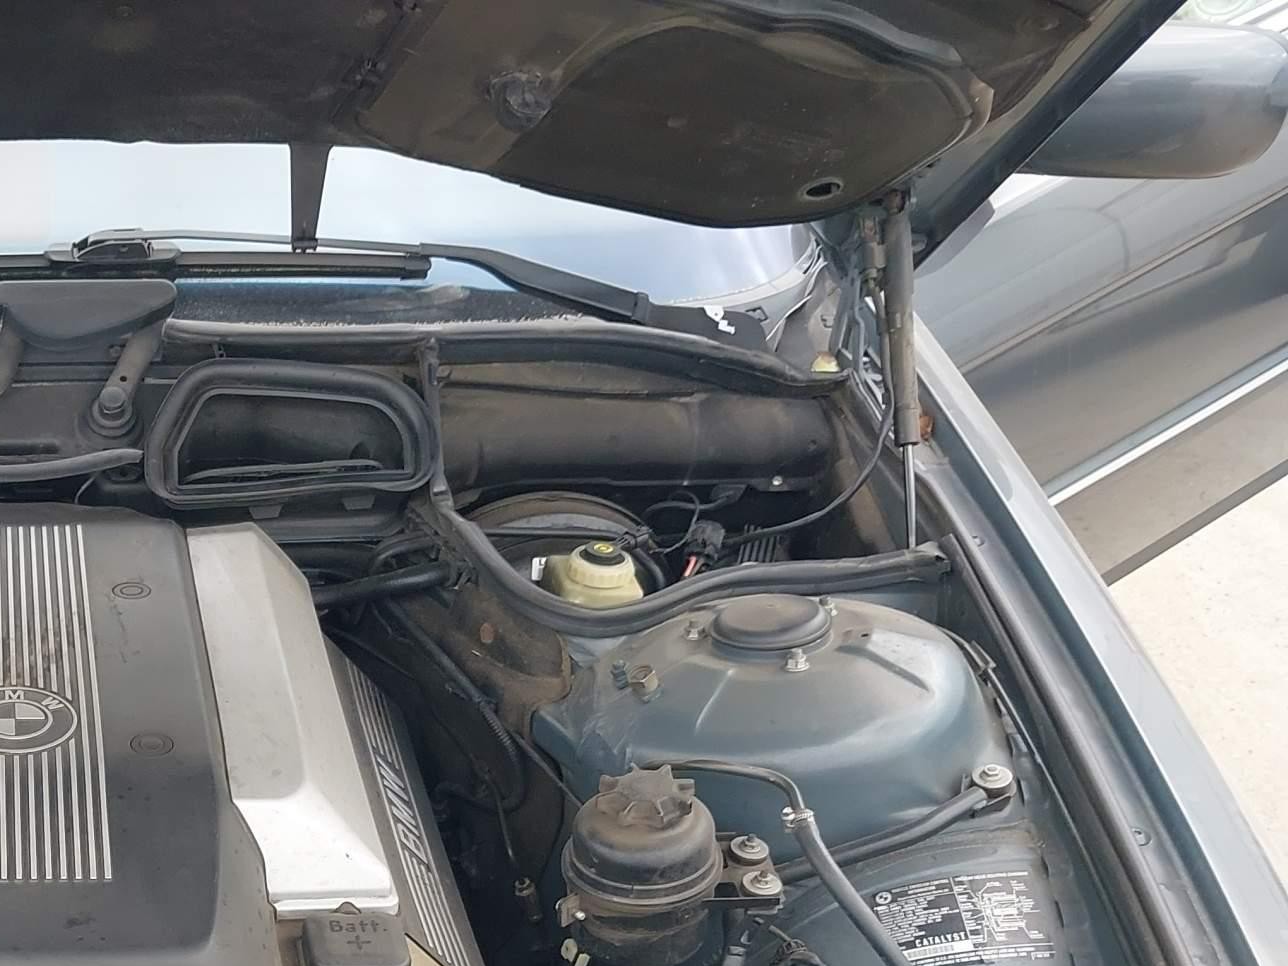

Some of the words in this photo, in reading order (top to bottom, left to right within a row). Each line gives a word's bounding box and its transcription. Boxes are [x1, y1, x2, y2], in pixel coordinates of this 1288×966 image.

[376, 754, 428, 864] BMW
[329, 920, 388, 932] Batt.
[915, 931, 966, 947] CATALYST
